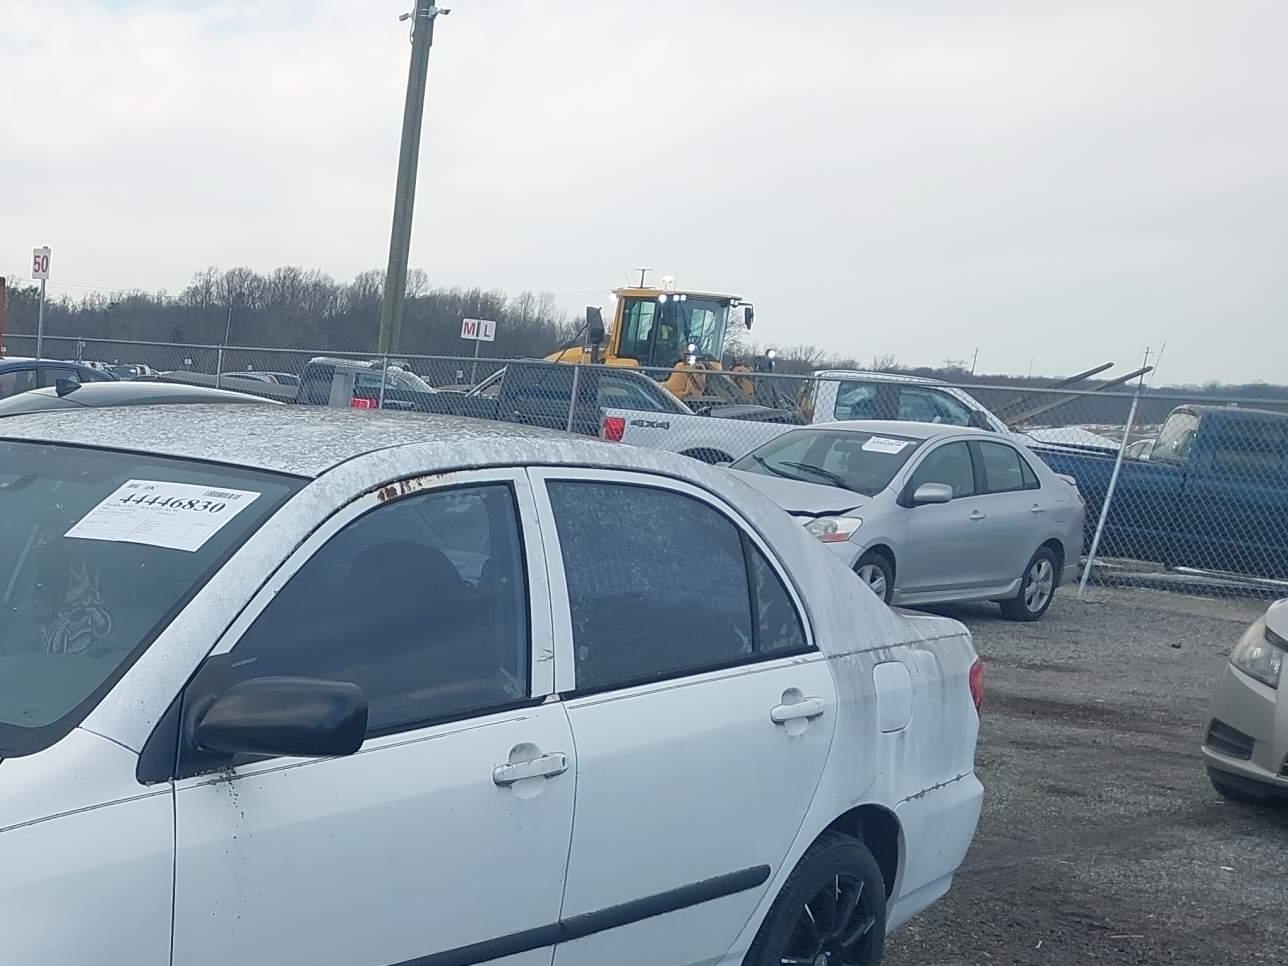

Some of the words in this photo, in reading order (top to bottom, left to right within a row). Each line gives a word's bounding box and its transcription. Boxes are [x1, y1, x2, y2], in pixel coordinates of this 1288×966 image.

[34, 255, 49, 273] 50
[463, 321, 476, 336] M
[483, 324, 491, 338] L
[119, 493, 227, 514] 44446830
